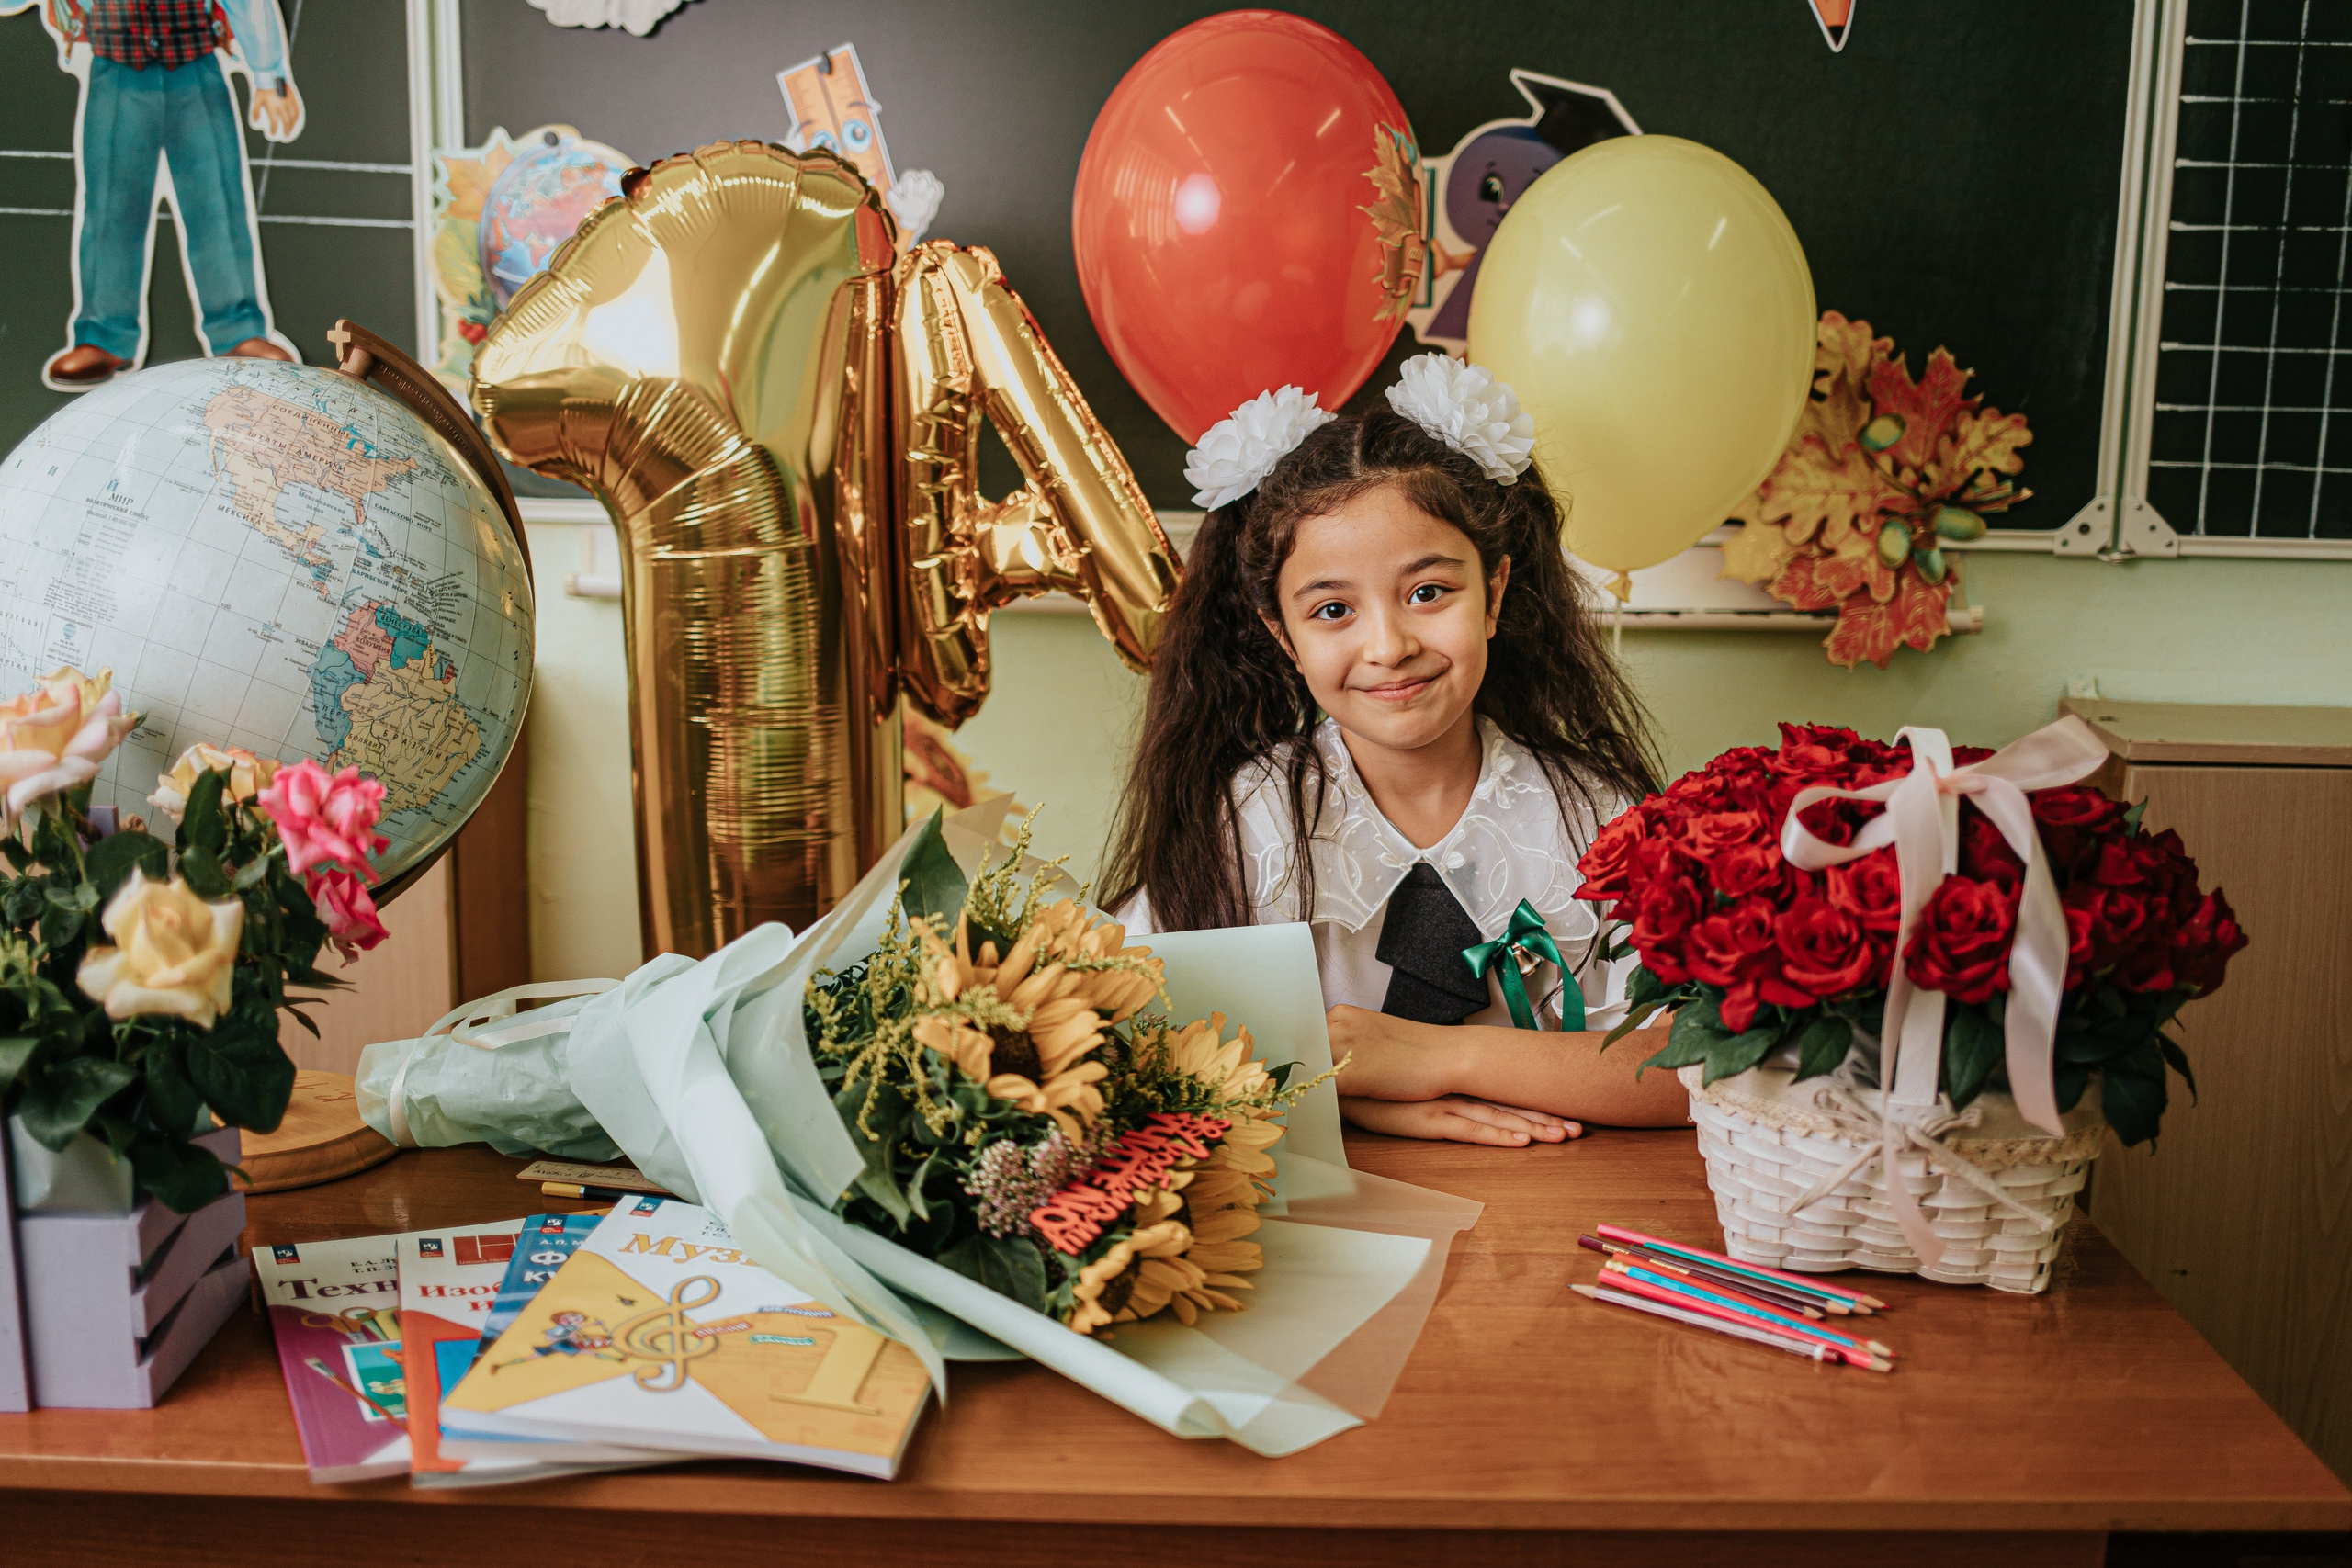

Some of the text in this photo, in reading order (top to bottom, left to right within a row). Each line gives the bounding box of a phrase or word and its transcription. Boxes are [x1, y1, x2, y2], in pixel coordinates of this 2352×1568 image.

[271, 403, 352, 438] СОЕДИНЕННЫЕ
[247, 430, 346, 472] ШТАТЫ АМЕРИКИ
[107, 491, 134, 507] МИР
[297, 491, 346, 514] Мексиканский
[216, 503, 262, 525] МЕКСИКА
[374, 502, 433, 533] САРГАССОВО МОРЕ
[351, 568, 390, 586] КАРИБСКОЕ
[390, 583, 409, 594] МОРЕ
[220, 602, 232, 610] 100
[379, 615, 422, 635] ВЕНЕСУЭЛА
[294, 637, 320, 650] ЭКВАДОР
[355, 637, 390, 654] КОЛУМБИЯ
[322, 705, 349, 719] ПЕРУ
[347, 732, 382, 750] БОЛИВИЯ
[380, 728, 451, 762] БРАЗИЛИЯ
[277, 1277, 397, 1301] Техн
[770, 1323, 886, 1416] 1
